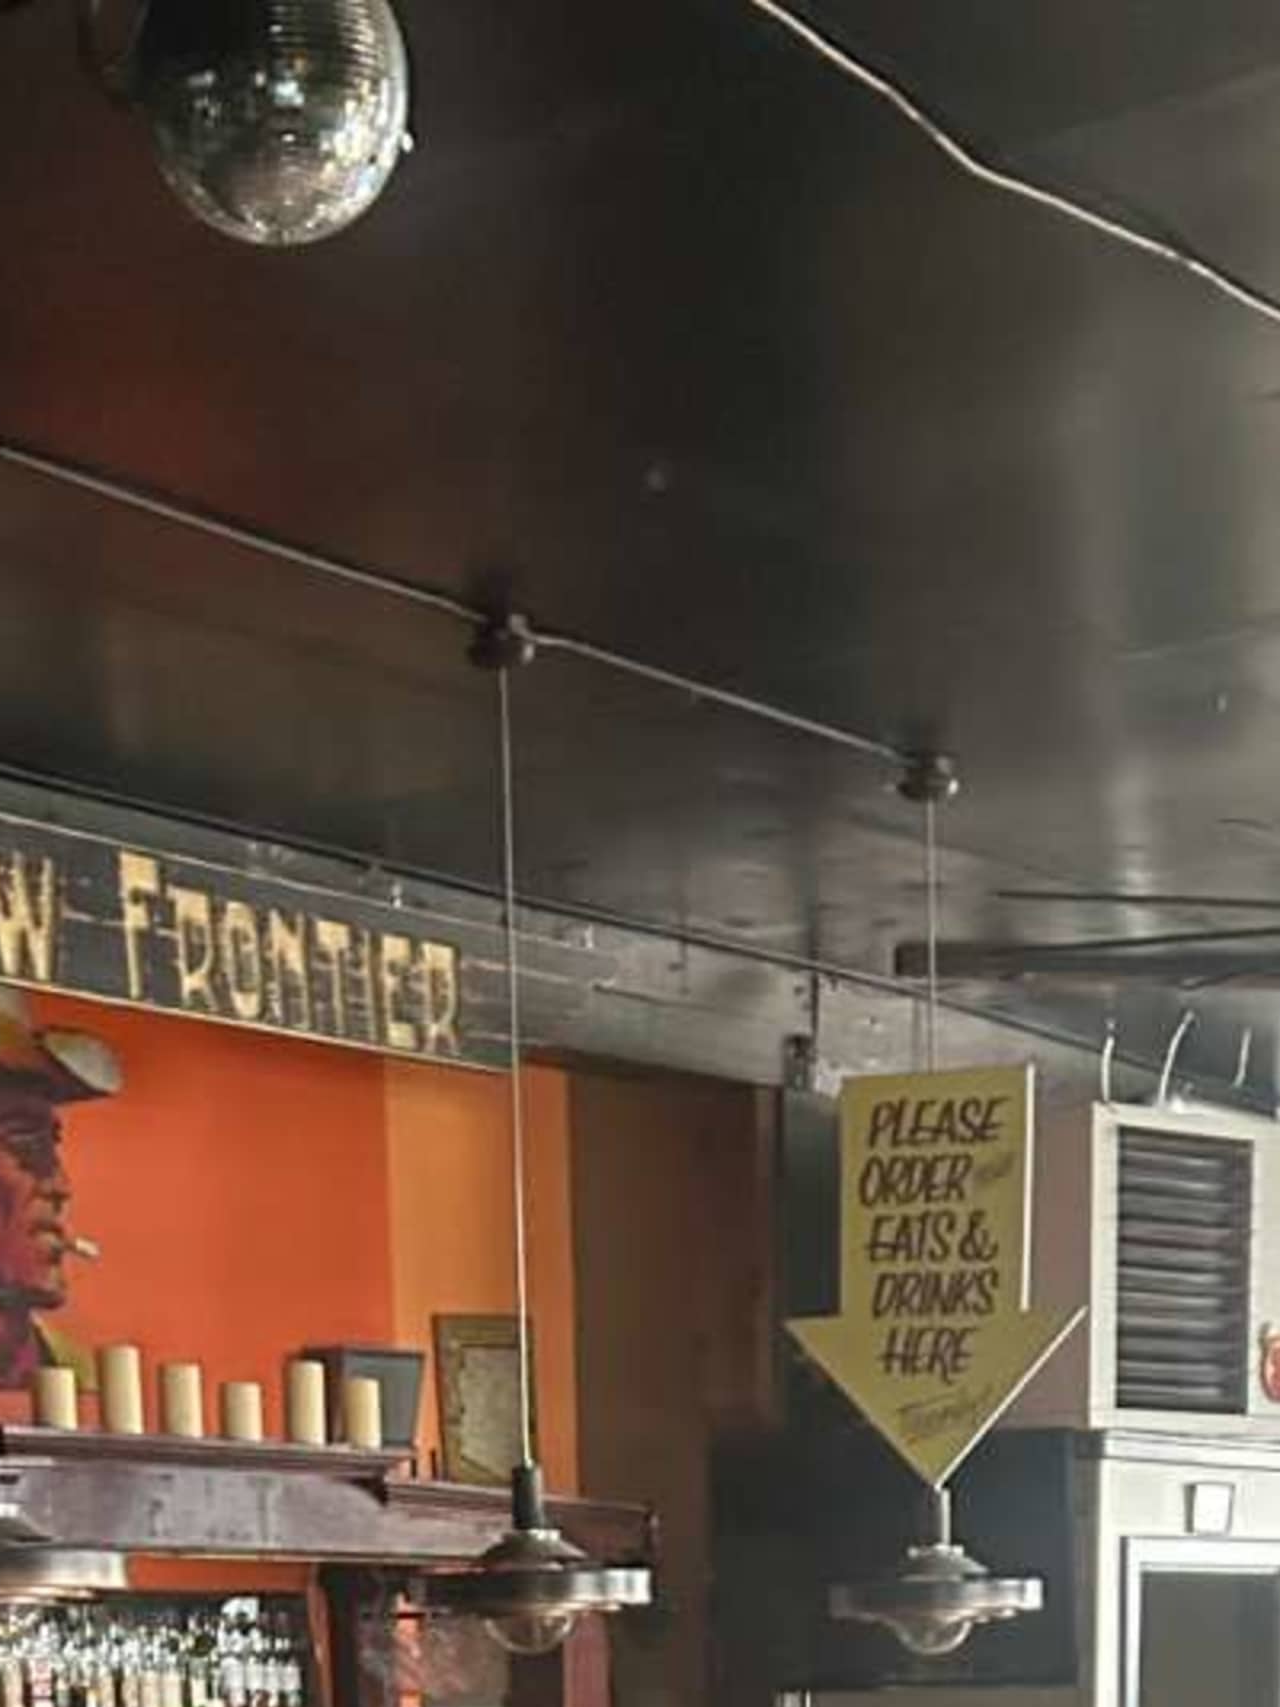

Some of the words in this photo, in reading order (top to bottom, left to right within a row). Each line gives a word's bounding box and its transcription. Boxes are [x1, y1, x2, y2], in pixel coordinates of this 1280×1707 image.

[120, 852, 460, 1058] FRONTIER
[868, 1096, 1009, 1147] PLEASE
[859, 1153, 973, 1206] ORDER
[863, 1210, 956, 1262] EATS
[960, 1208, 999, 1262] &
[872, 1267, 999, 1319] DRINKS
[877, 1327, 977, 1386] HERE
